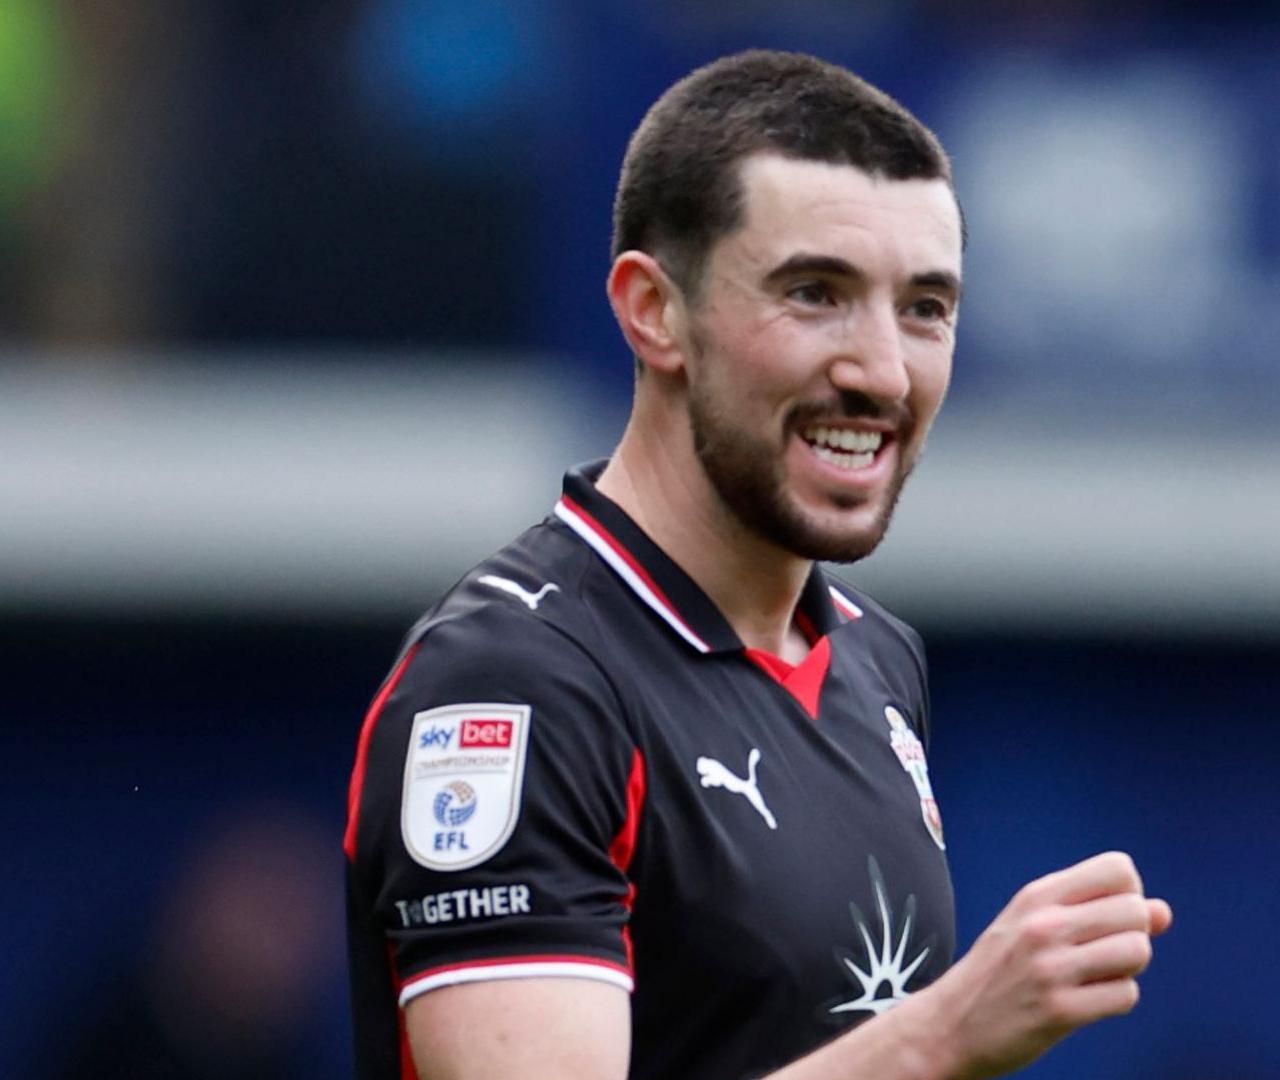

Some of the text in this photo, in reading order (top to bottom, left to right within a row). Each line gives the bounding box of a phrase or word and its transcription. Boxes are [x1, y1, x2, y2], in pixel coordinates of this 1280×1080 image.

[419, 721, 509, 749] sky bet
[435, 832, 469, 851] EFL
